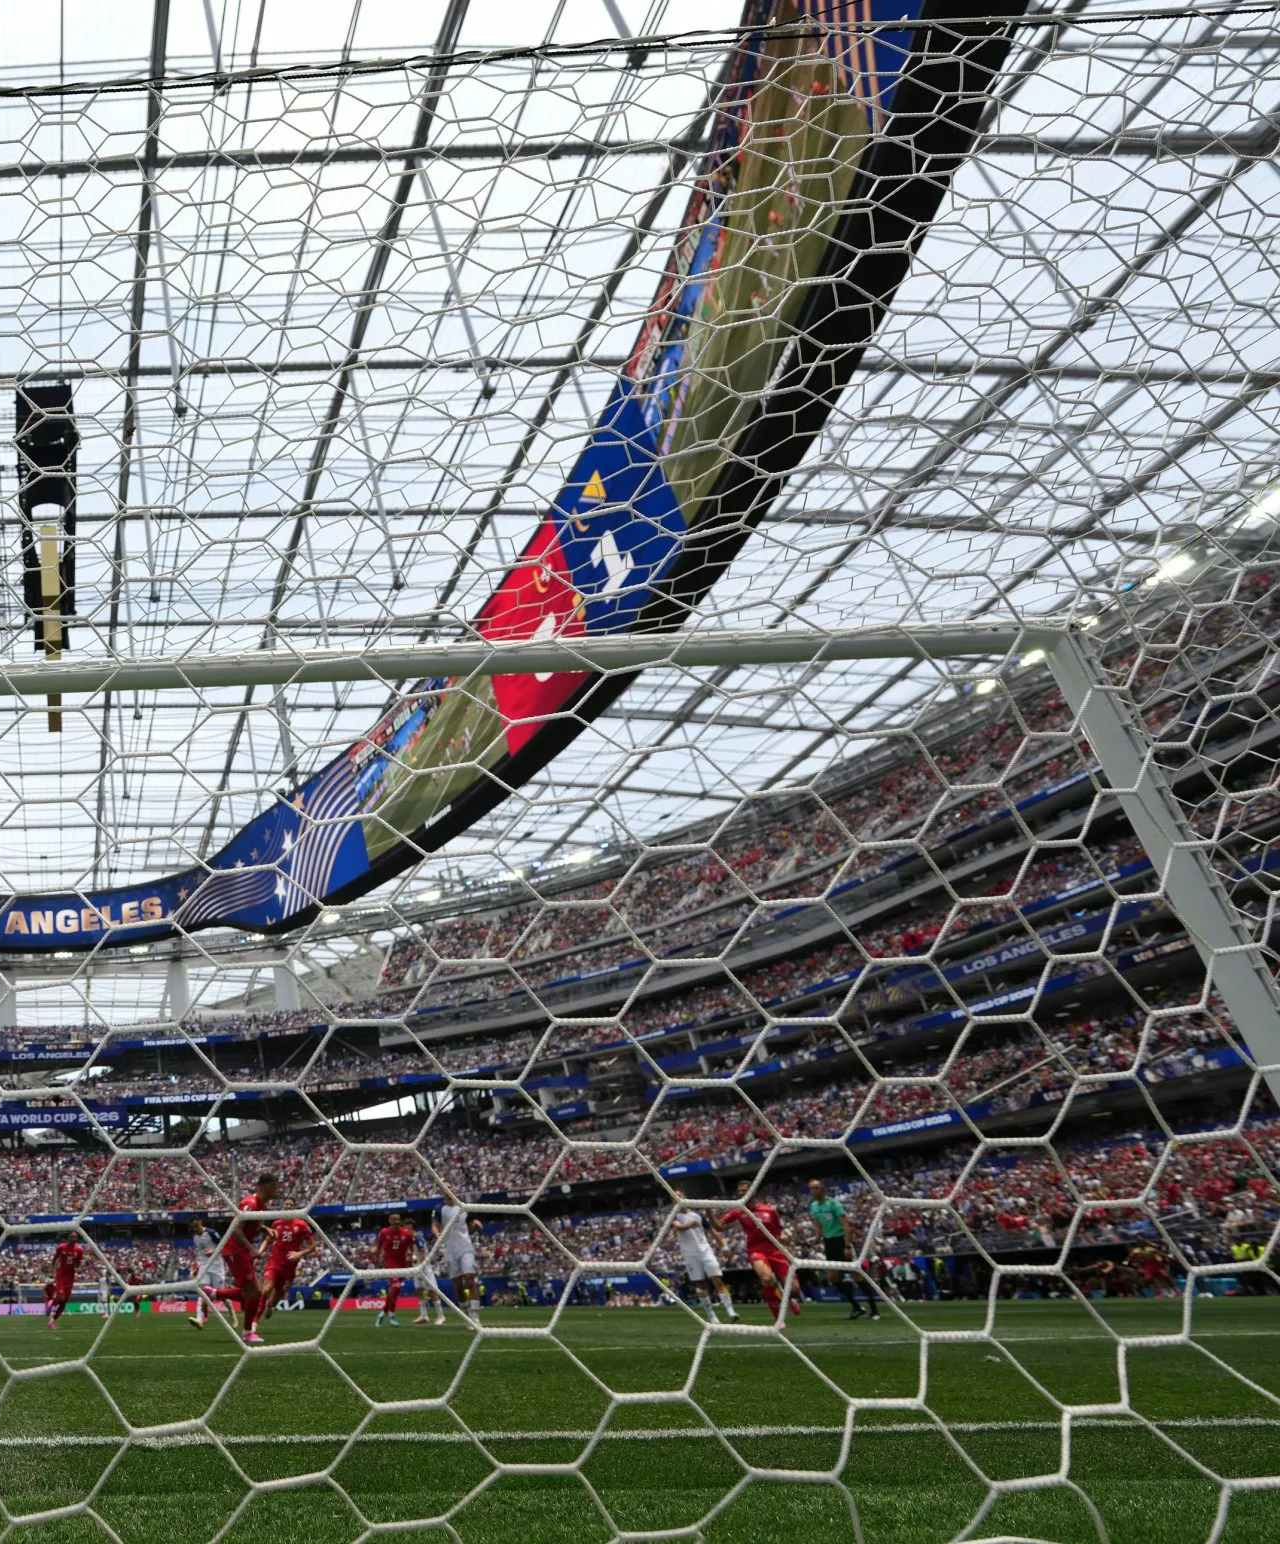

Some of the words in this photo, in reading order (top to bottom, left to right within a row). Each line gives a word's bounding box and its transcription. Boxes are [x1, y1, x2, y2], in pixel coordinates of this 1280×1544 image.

[5, 897, 162, 935] ANGELES
[962, 954, 997, 975] LOS
[1001, 923, 1087, 963] ANGELES
[37, 1051, 91, 1060] ANGELES
[144, 1095, 162, 1105] FIFA
[163, 1094, 190, 1104] WORLD
[191, 1093, 207, 1103] CUP
[10, 1114, 53, 1124] WORLD
[53, 1113, 77, 1123] CUP
[282, 1231, 293, 1243] 26
